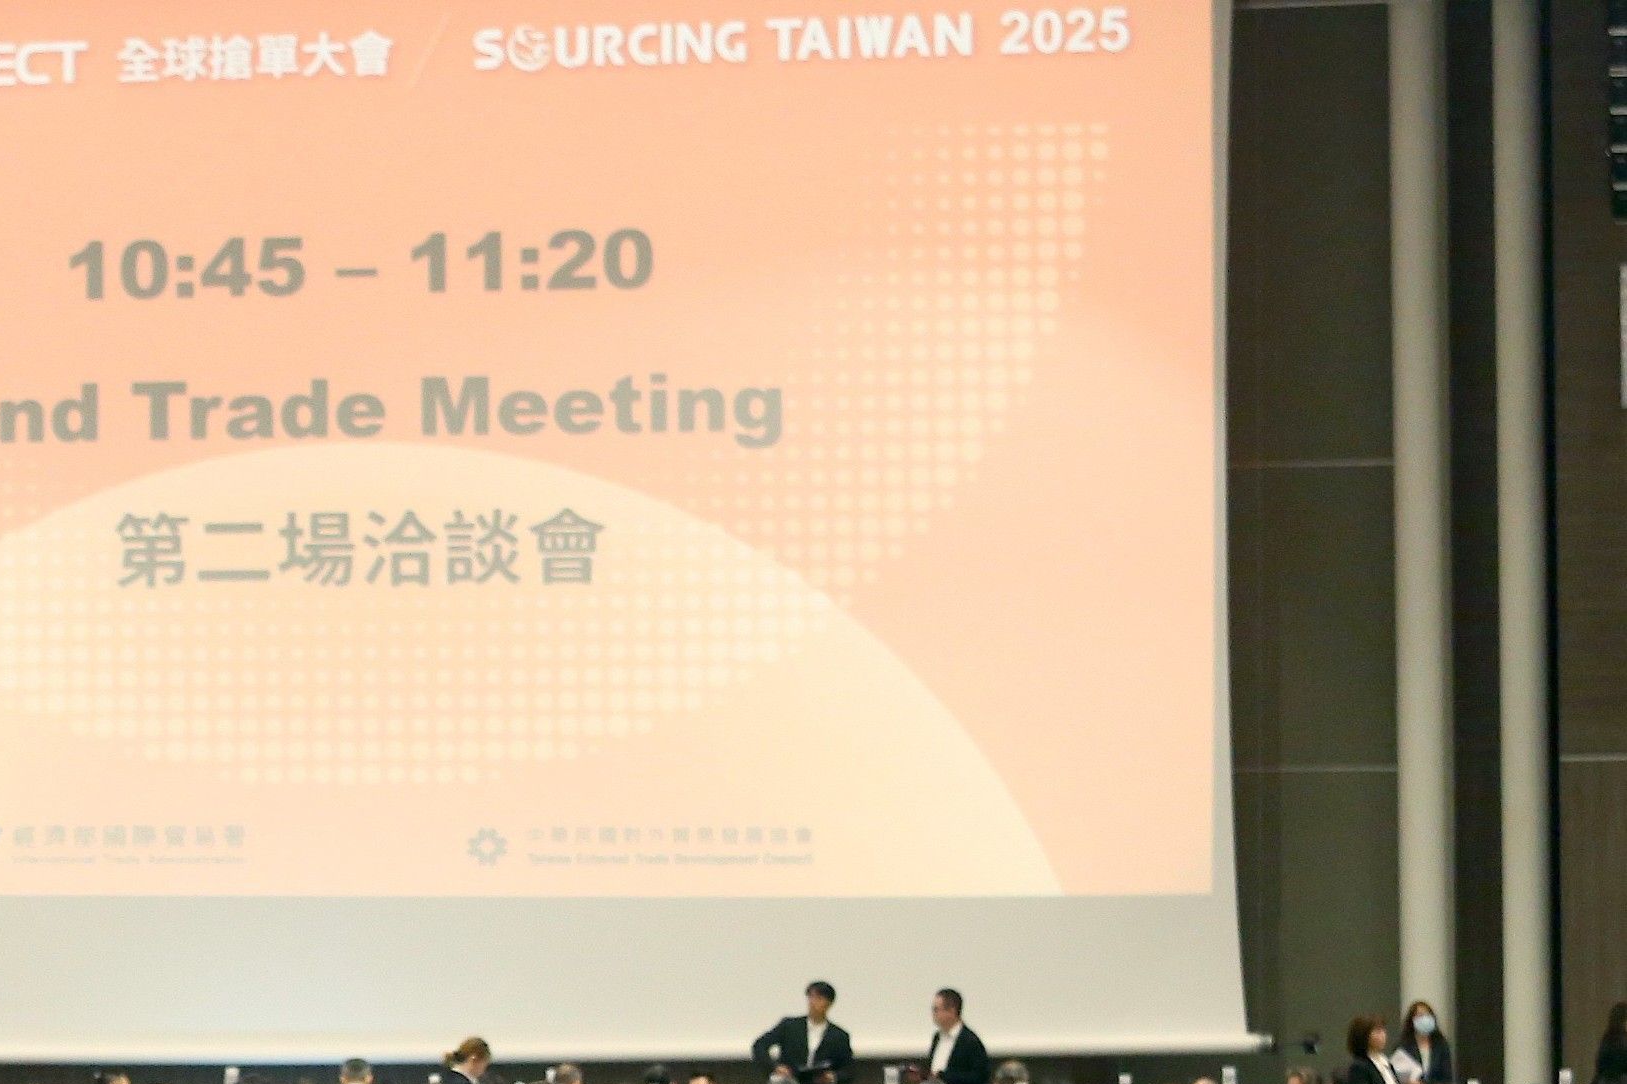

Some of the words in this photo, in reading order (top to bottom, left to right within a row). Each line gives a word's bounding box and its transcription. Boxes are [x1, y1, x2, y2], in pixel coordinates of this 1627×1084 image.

[473, 21, 748, 71] SOURCING
[769, 14, 974, 62] TAIWAN
[999, 8, 1132, 57] 2025
[70, 236, 307, 301] 10:45
[409, 229, 654, 292] 11:20
[132, 378, 387, 442] Trade
[419, 372, 783, 449] Meeting
[116, 508, 605, 589] 第二場洽談會
